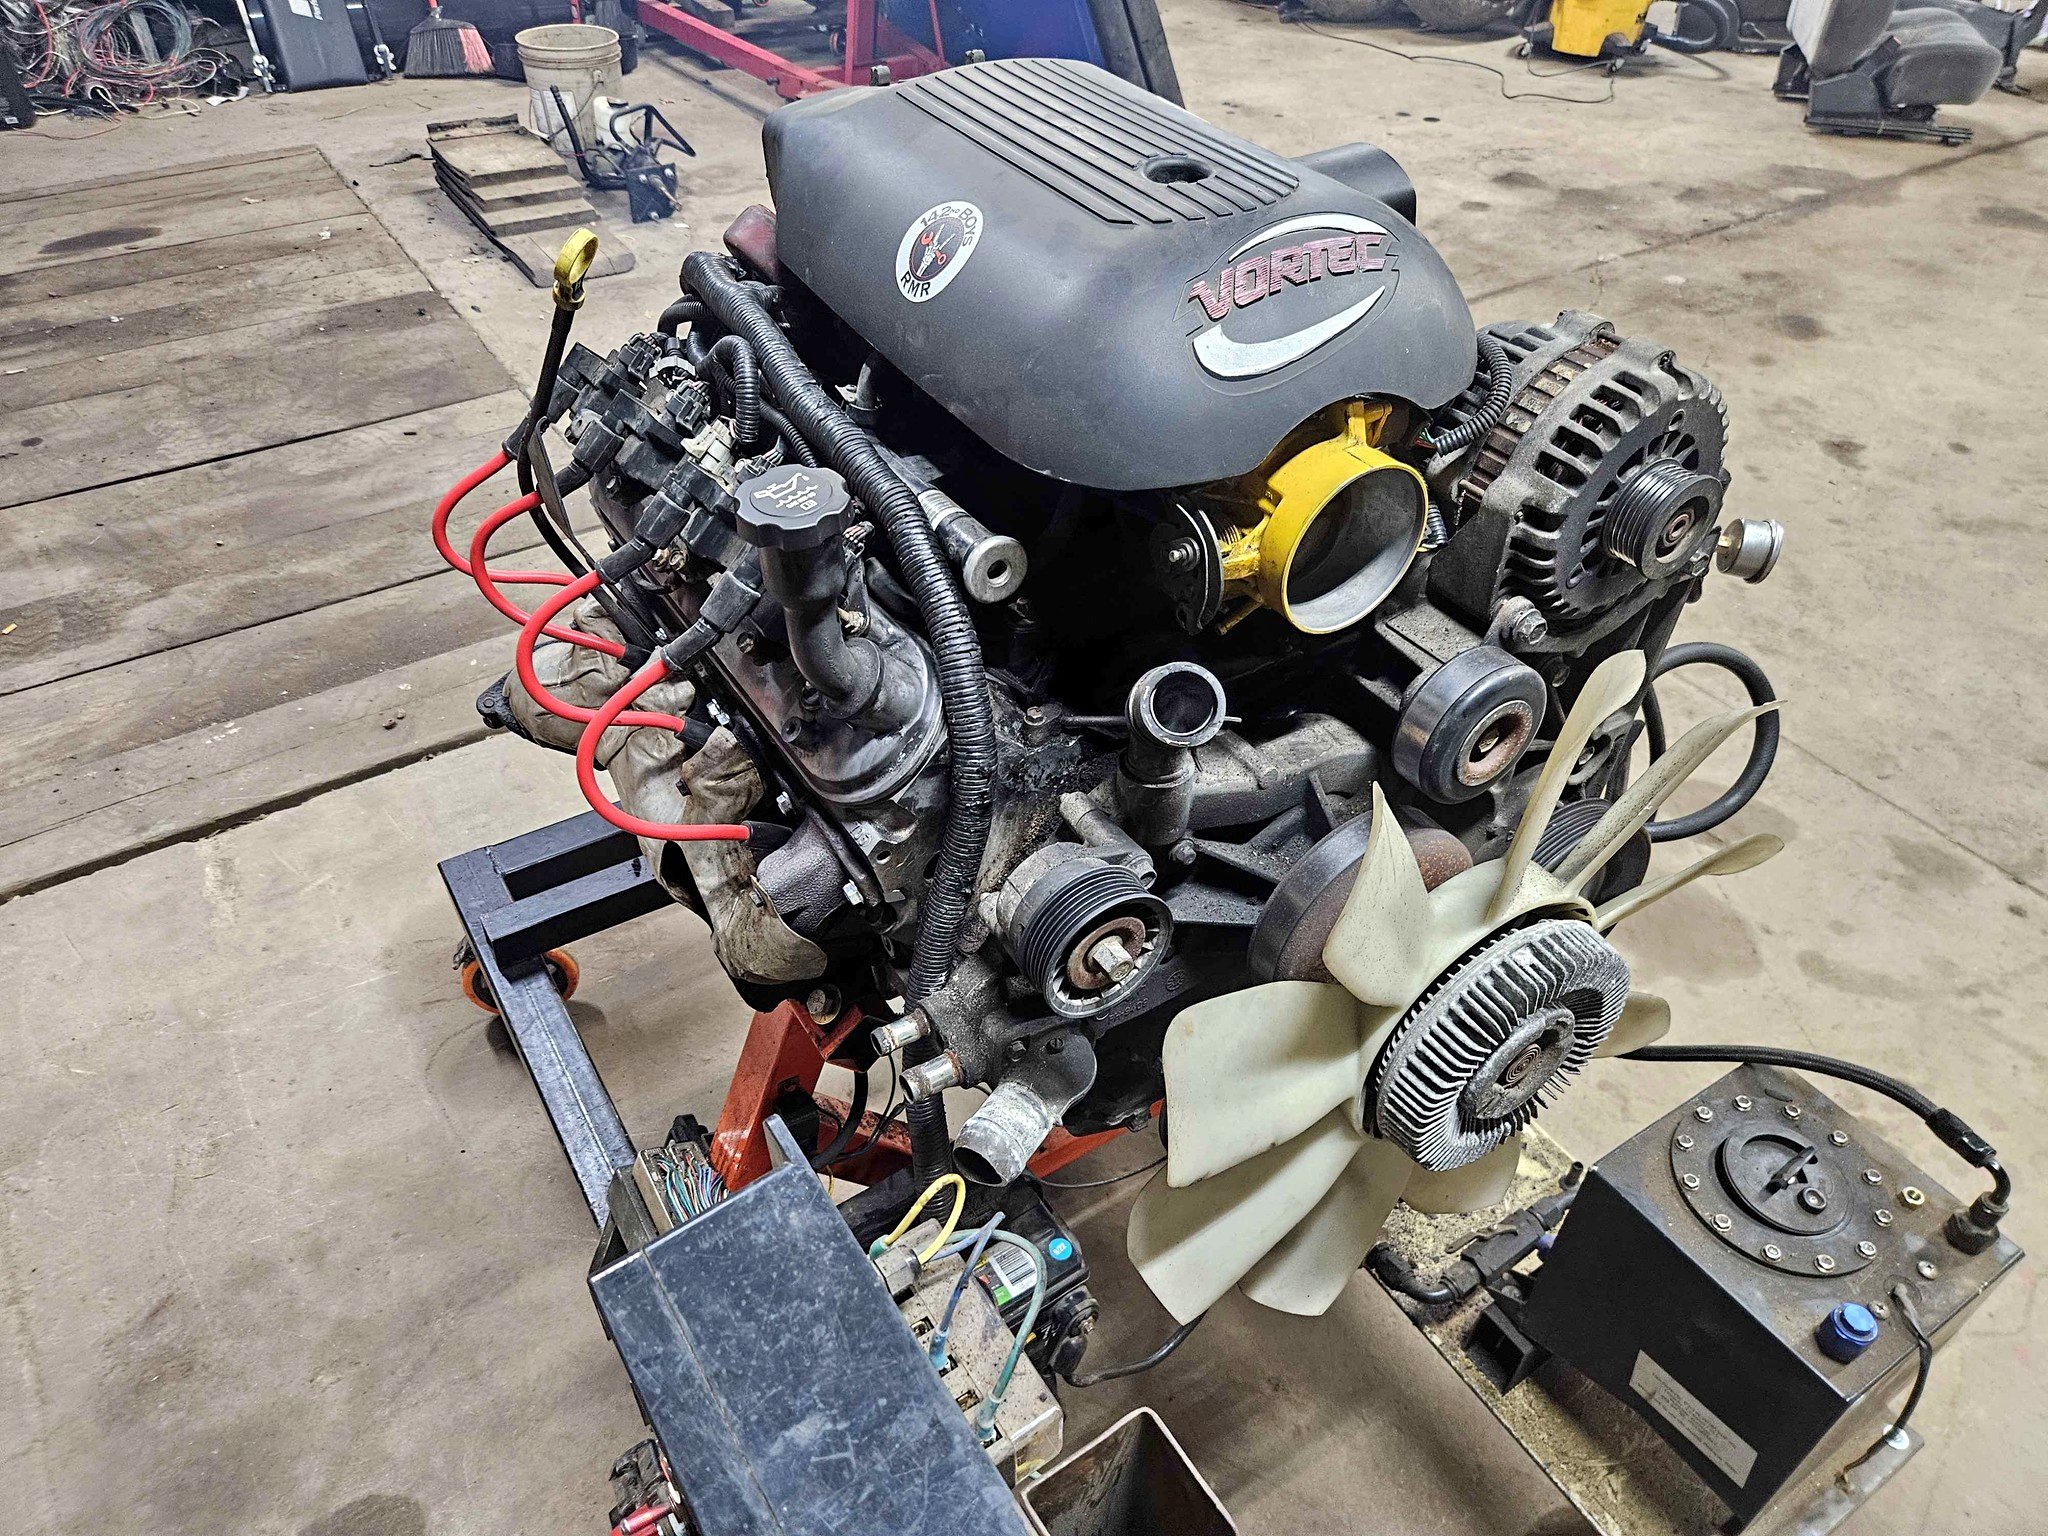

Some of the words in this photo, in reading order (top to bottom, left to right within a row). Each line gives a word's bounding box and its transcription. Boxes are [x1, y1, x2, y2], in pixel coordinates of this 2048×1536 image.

[959, 207, 977, 247] BOYS
[900, 270, 931, 298] RMR
[1188, 234, 1387, 322] VORTEC
